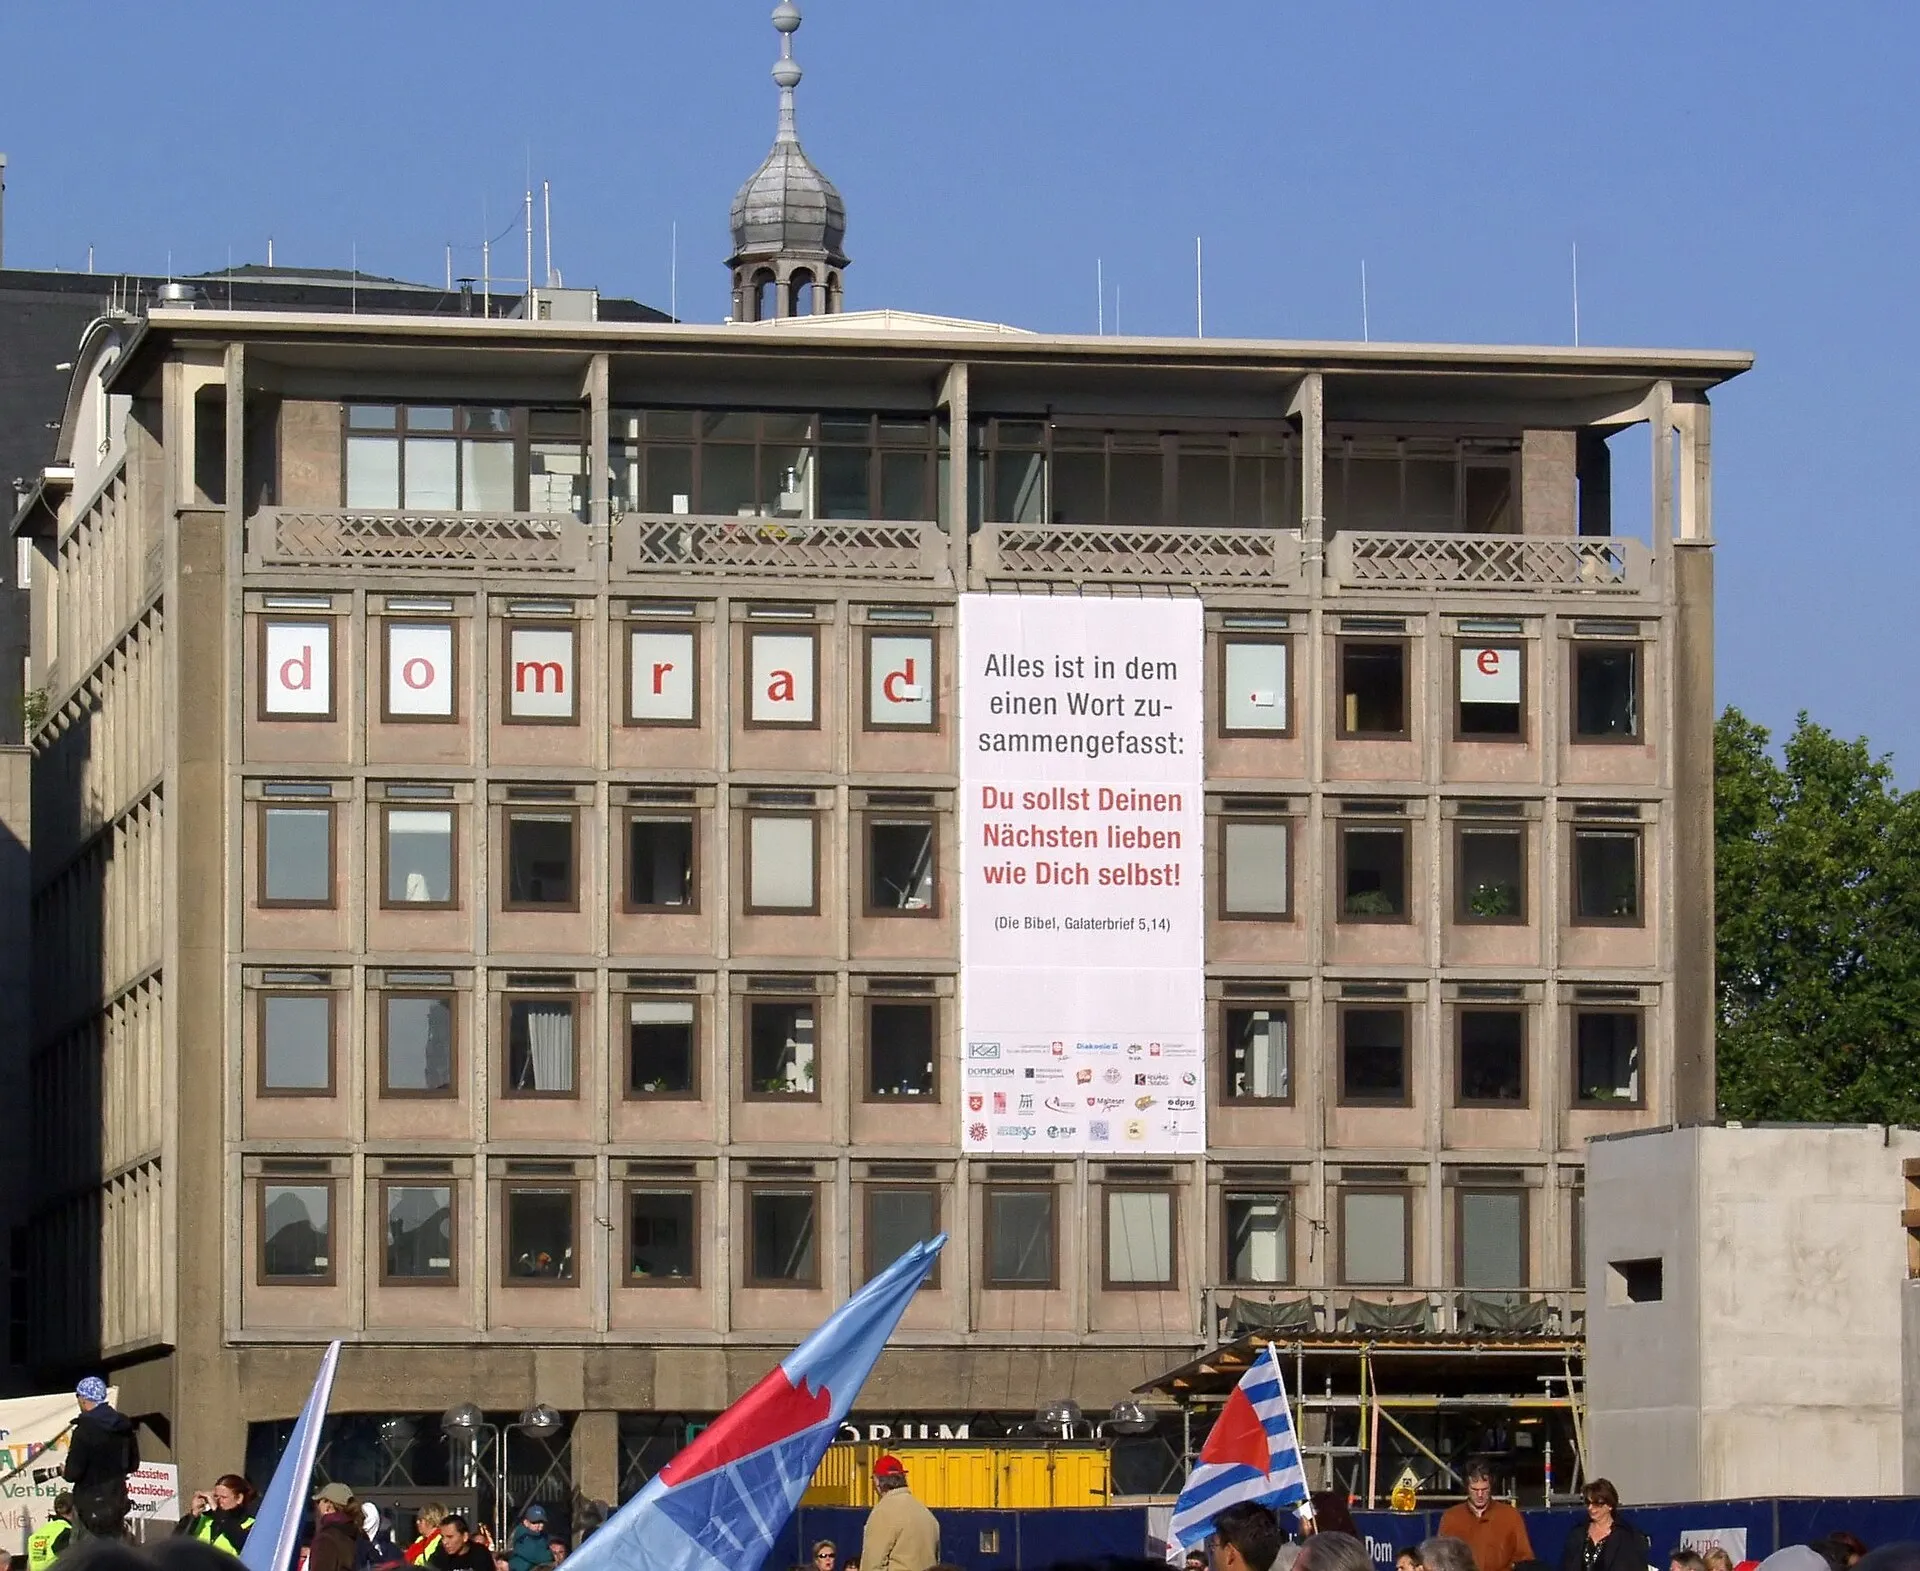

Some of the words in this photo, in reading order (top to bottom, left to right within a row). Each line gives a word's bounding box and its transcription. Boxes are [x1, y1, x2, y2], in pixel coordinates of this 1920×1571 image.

[984, 653, 1044, 678] Alles
[1055, 654, 1084, 678] ist
[1095, 655, 1115, 679] in
[1126, 656, 1177, 680] dem
[991, 691, 1057, 715] einen
[1067, 692, 1125, 716] Wort
[1134, 698, 1173, 717] zu-
[979, 731, 1184, 758] sammengefasst:
[983, 786, 1013, 810] Du
[1022, 787, 1090, 811] sollst
[1099, 788, 1182, 812] Deinen
[984, 824, 1098, 848] Nächsten
[1107, 825, 1181, 849] lieben
[984, 861, 1026, 885] wie
[1036, 862, 1089, 885] Dich
[1099, 862, 1180, 886] selbst!
[995, 916, 1019, 931] (Die
[1024, 916, 1060, 932] Bibel,
[1064, 917, 1135, 931] Galaterbrief
[1138, 917, 1171, 932] 5,14)
[1174, 1098, 1195, 1107] dpsg
[132, 1469, 169, 1480] assisten
